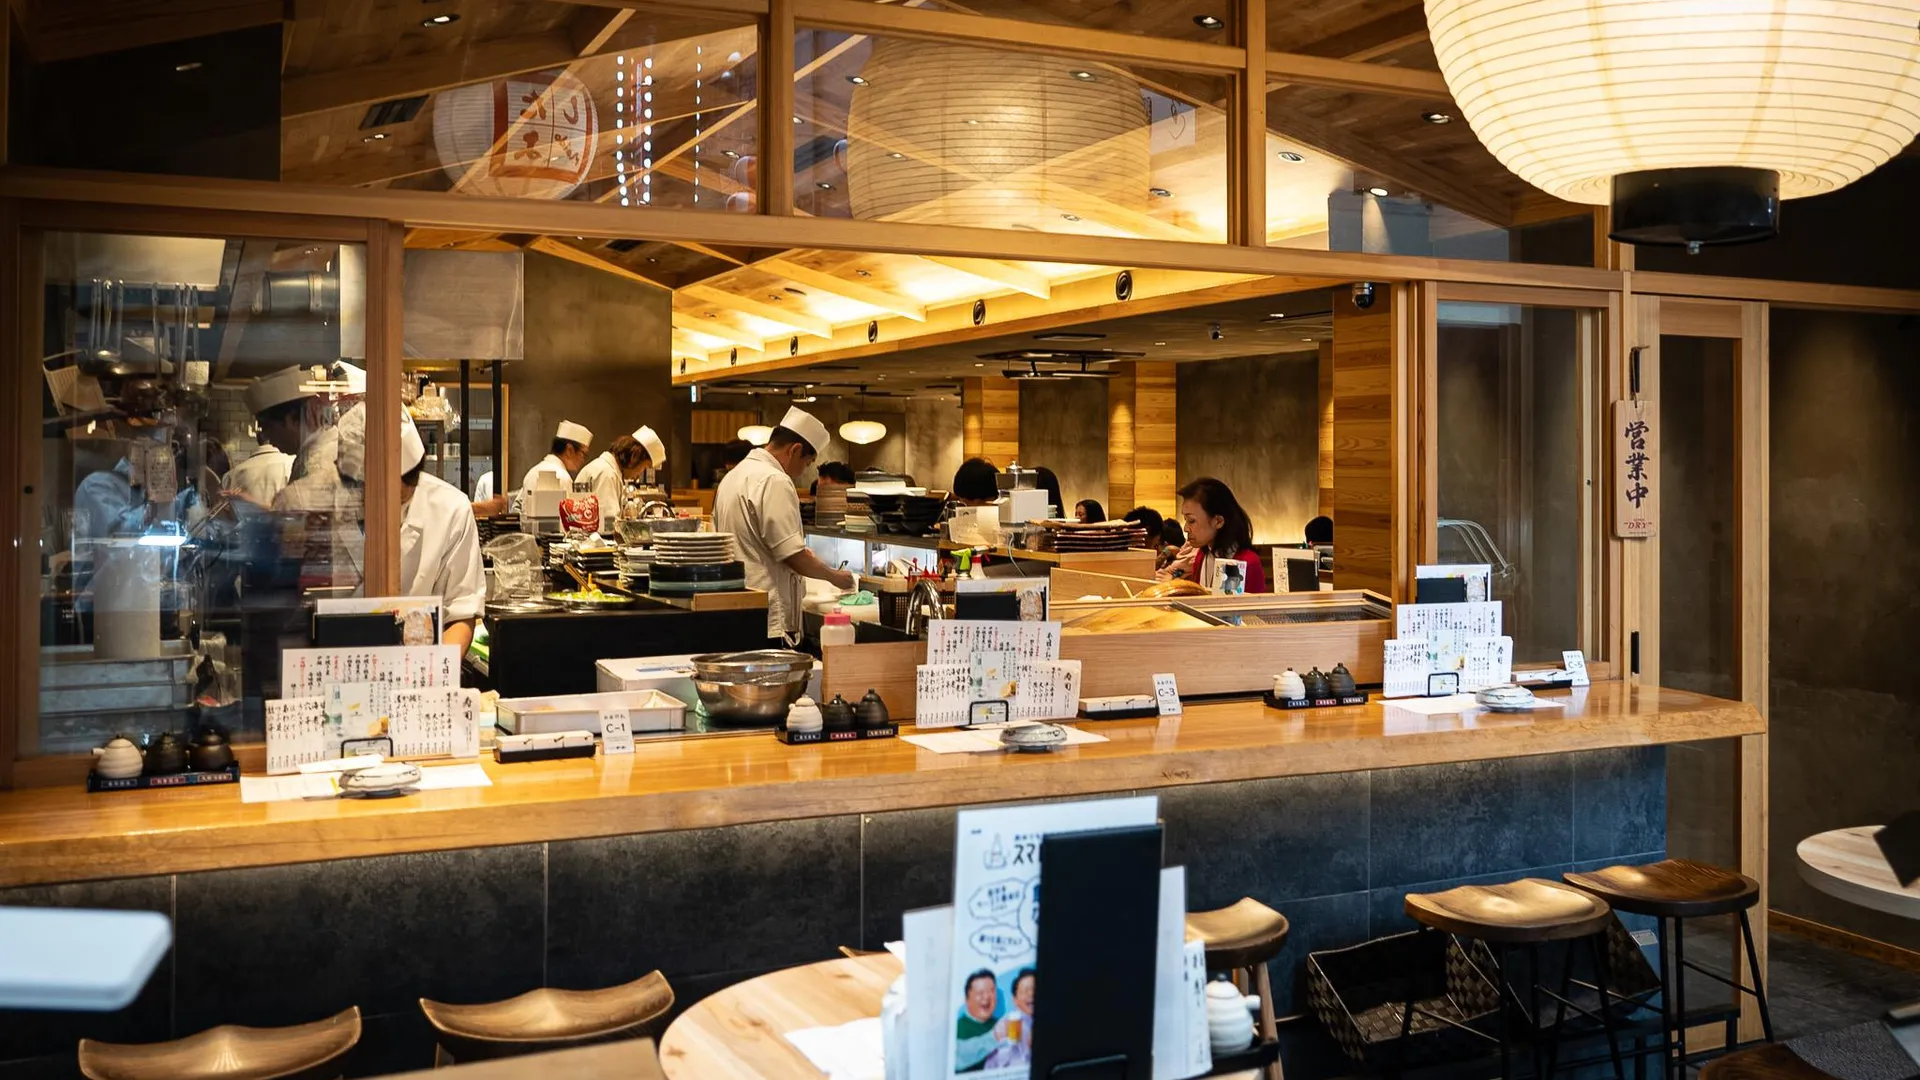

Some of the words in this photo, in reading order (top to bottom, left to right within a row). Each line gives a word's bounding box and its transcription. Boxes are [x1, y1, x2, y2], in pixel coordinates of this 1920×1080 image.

[1624, 420, 1650, 509] 営業中
[1158, 687, 1176, 697] C-3
[606, 723, 625, 733] C-1
